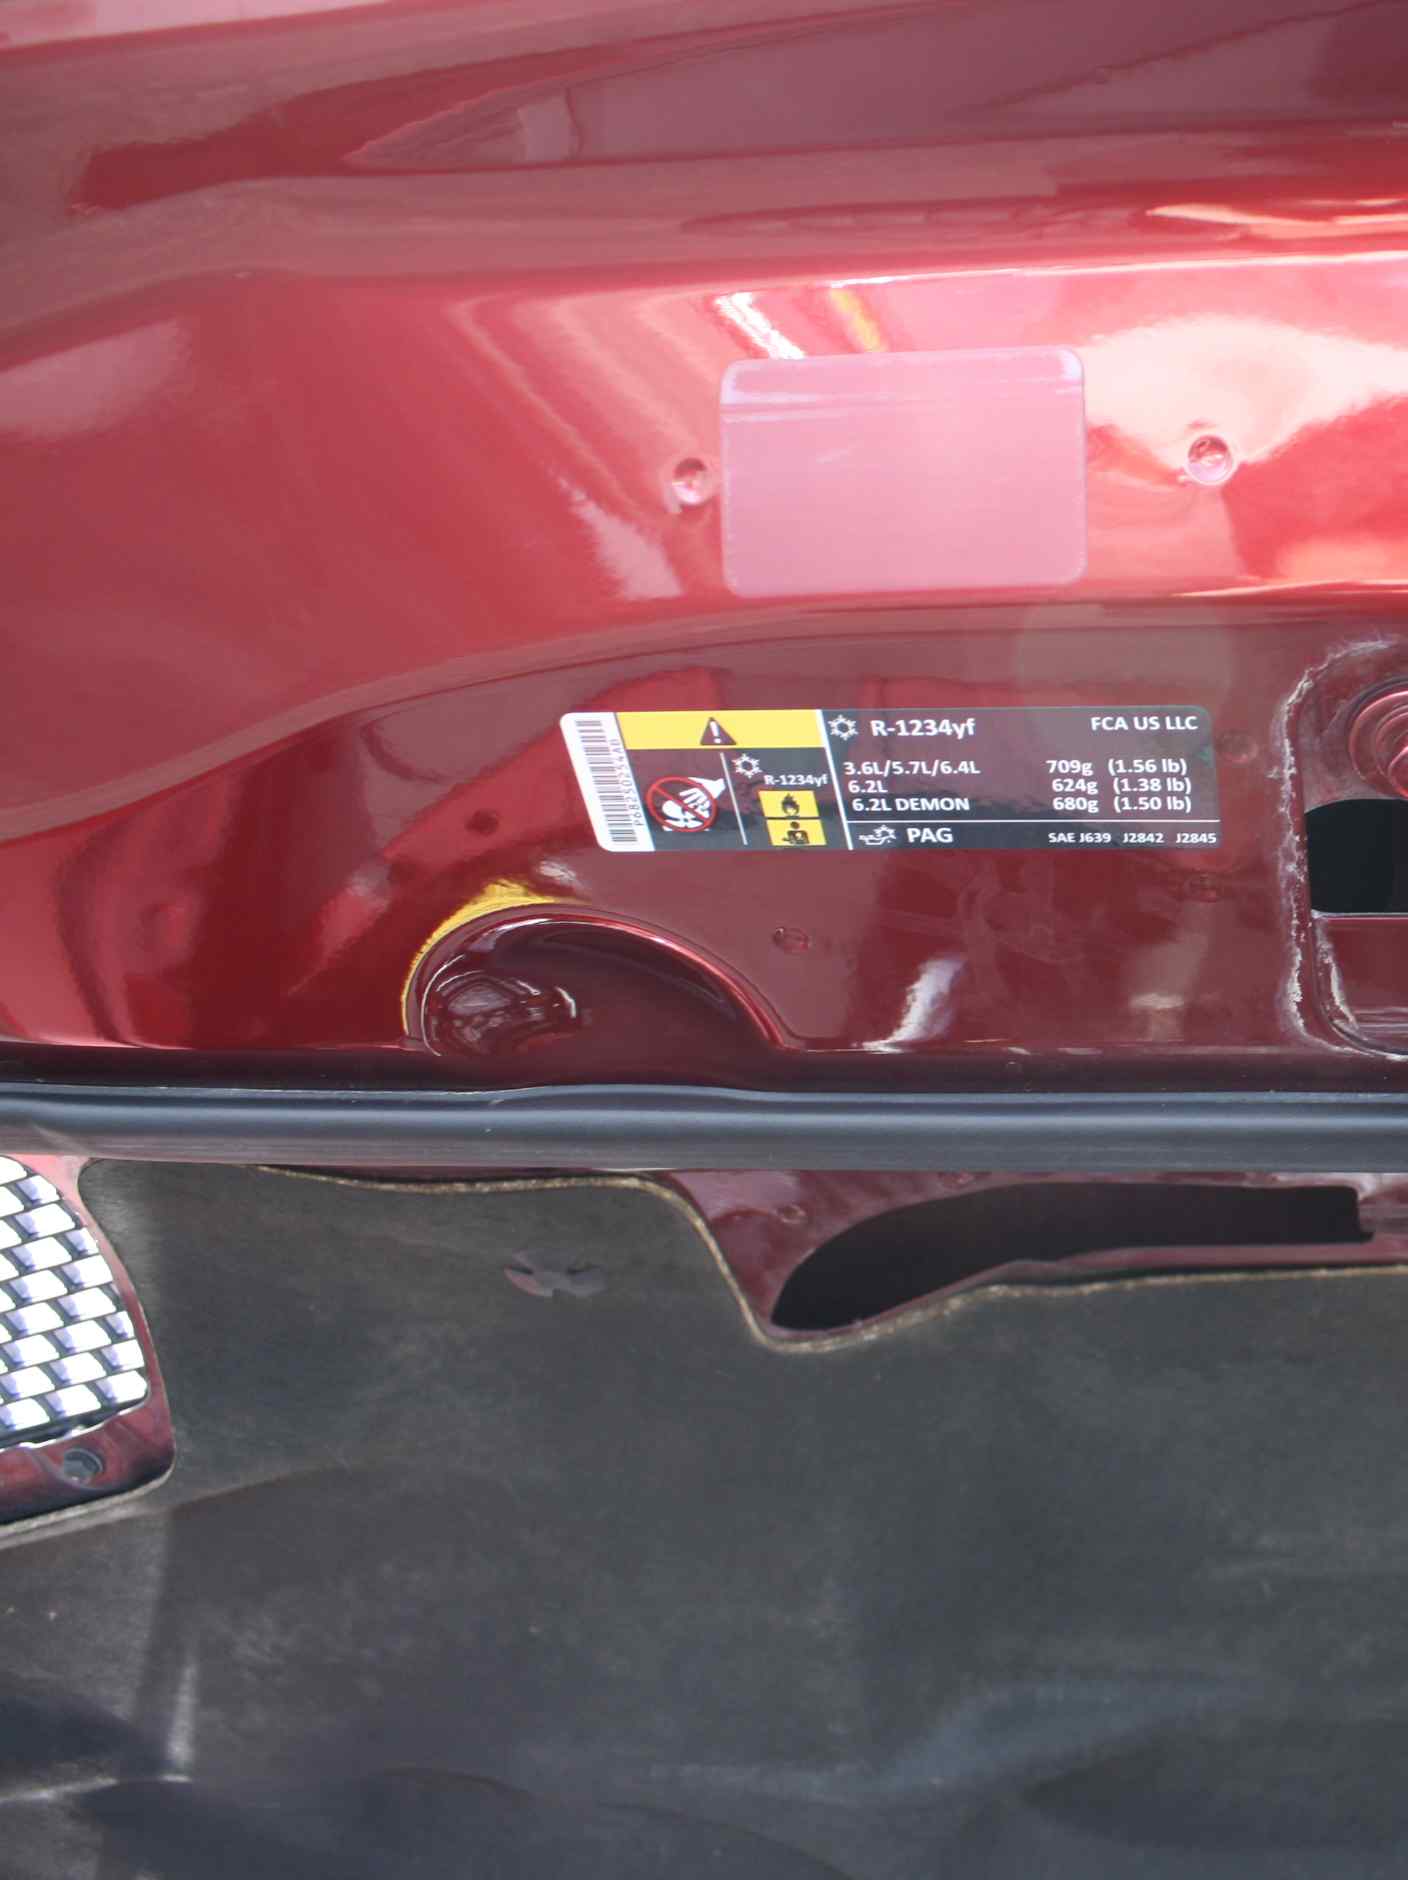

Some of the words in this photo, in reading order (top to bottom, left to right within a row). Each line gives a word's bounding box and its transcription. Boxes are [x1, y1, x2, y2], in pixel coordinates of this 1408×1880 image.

[870, 718, 976, 737] R-1234yf
[1091, 716, 1128, 731] FCA
[1133, 716, 1161, 731] US
[1165, 716, 1198, 730] LLC
[843, 760, 981, 776] 3.6L/5.7L/6.4L
[1046, 759, 1094, 777] 709g
[1108, 758, 1157, 776] (1.56
[1161, 758, 1187, 776] lb)
[764, 773, 828, 787] R-1234yf
[848, 779, 888, 794] 6.2L
[1052, 778, 1098, 796] 624g
[1113, 777, 1161, 795] (1.38
[1166, 777, 1192, 795] lb)
[852, 797, 892, 812] 6.2L
[896, 797, 970, 811] DEMON
[1052, 796, 1099, 814] 680g
[1113, 795, 1162, 813] (1.50
[1166, 795, 1192, 813] lb)
[906, 827, 954, 843] PAG
[1047, 832, 1076, 843] SAE
[1078, 832, 1112, 844] J639
[1122, 832, 1164, 844] J2842
[1175, 832, 1217, 844] J2845
